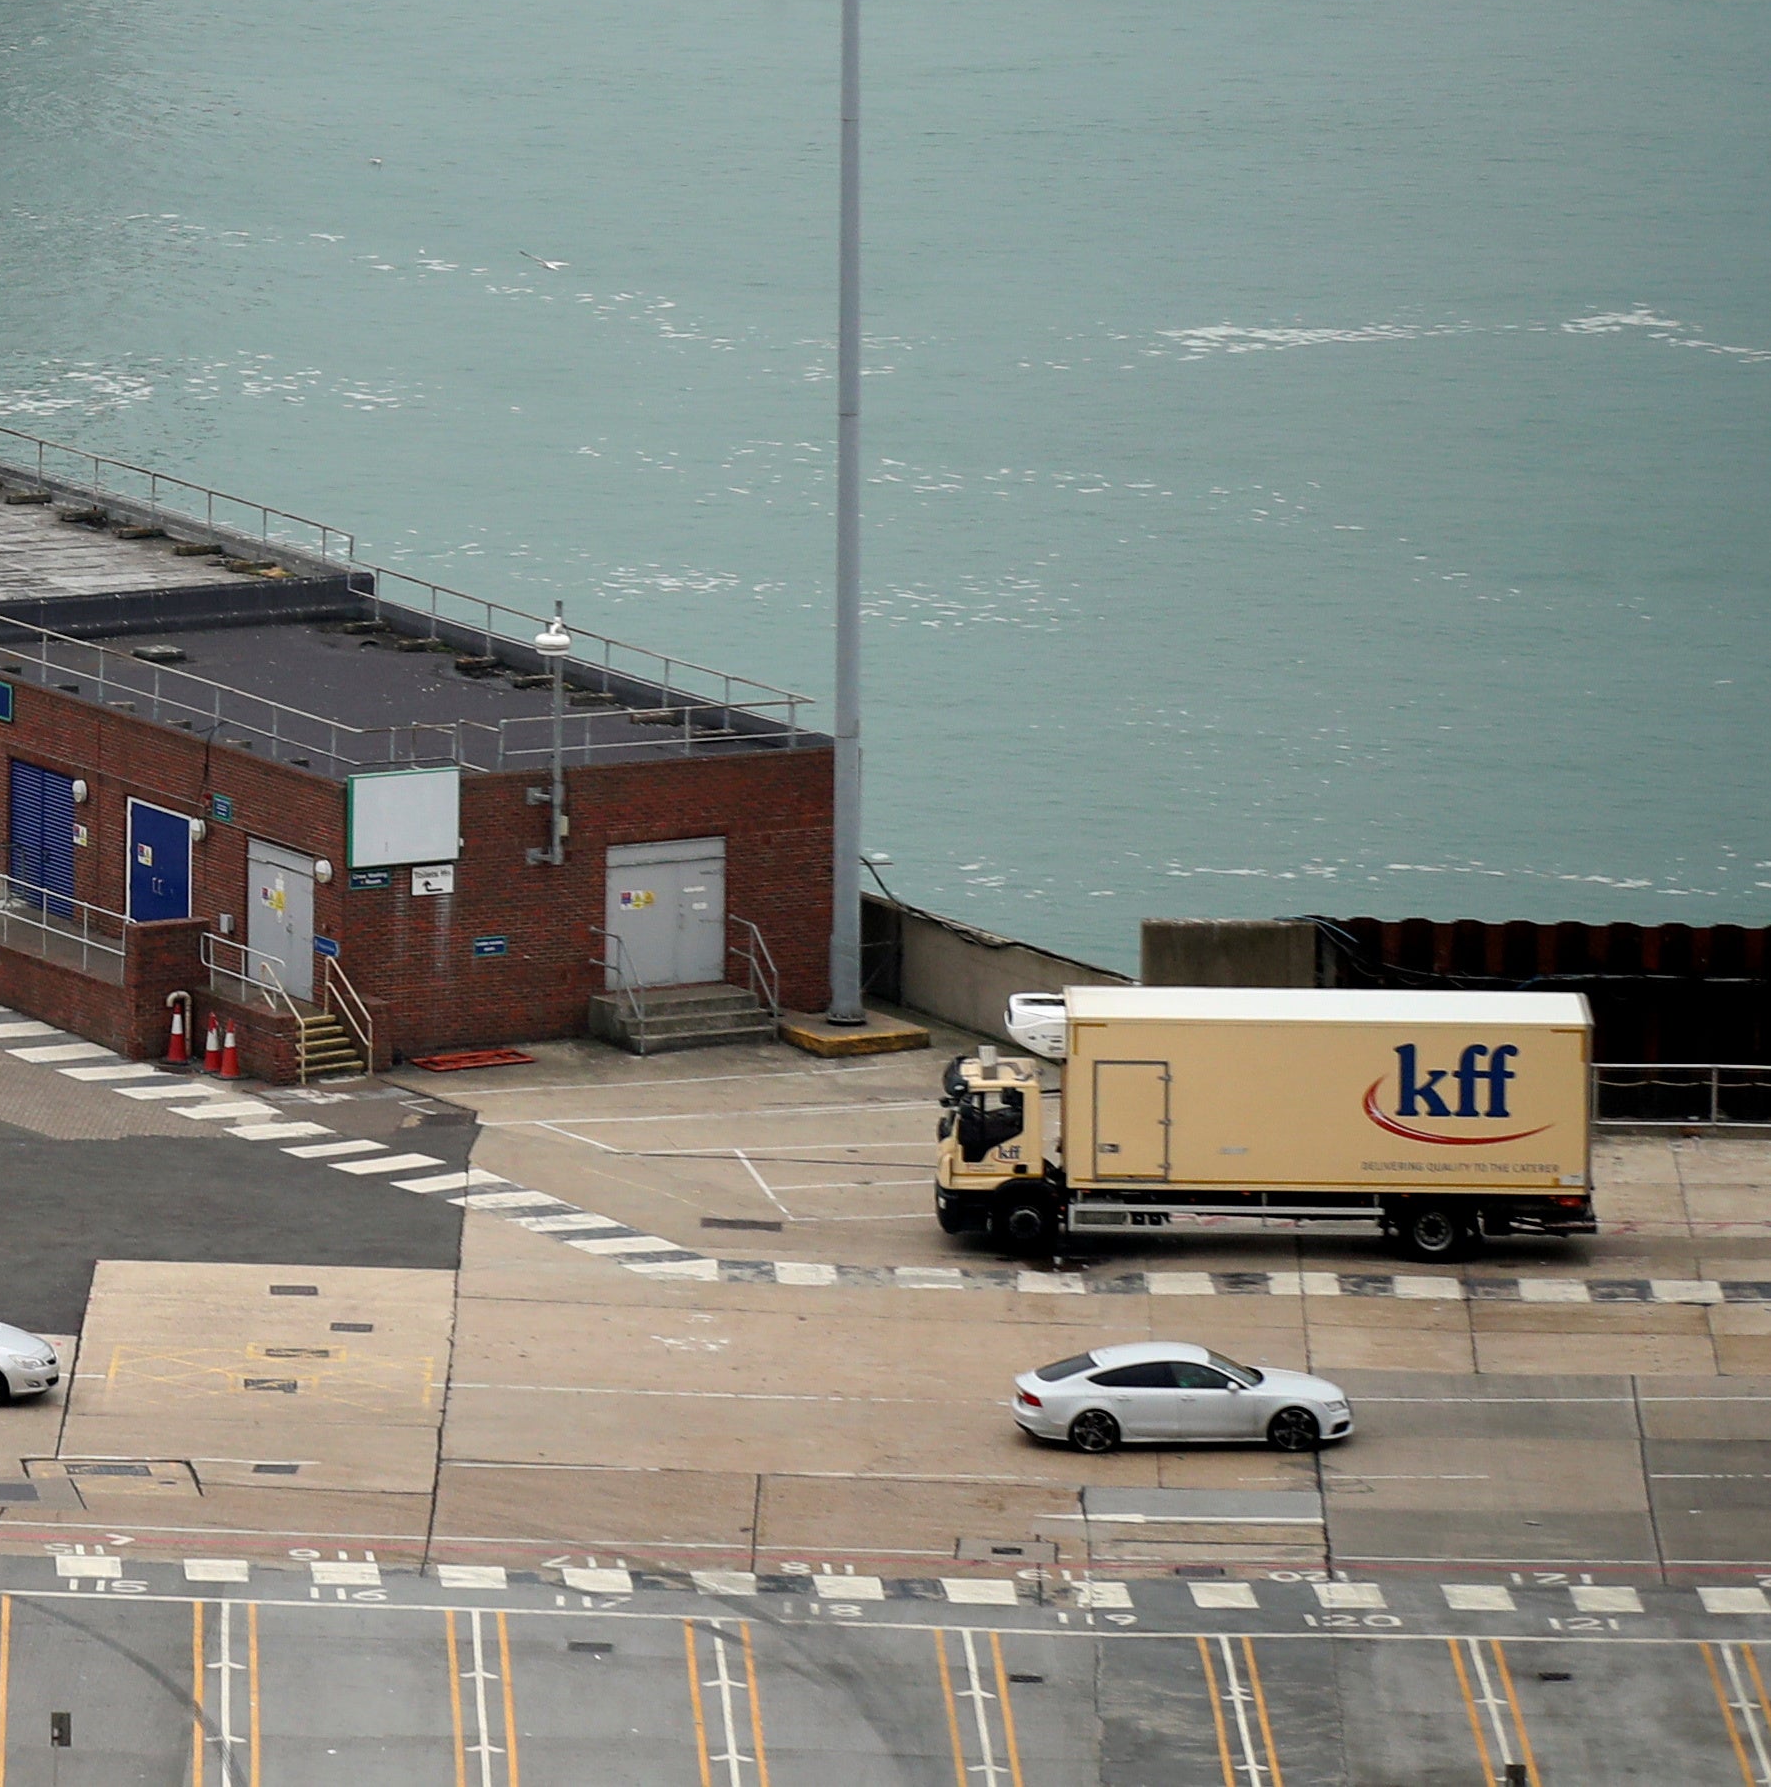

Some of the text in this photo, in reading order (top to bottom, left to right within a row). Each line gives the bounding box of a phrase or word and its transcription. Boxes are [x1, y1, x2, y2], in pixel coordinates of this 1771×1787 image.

[1393, 1043, 1518, 1119] kff
[998, 1145, 1022, 1159] kff
[1361, 1161, 1560, 1174] DELIVERING QUALITY TO THE CATERER
[68, 1579, 150, 1594] 115
[309, 1587, 389, 1602] 116
[1548, 1617, 1619, 1631] 121
